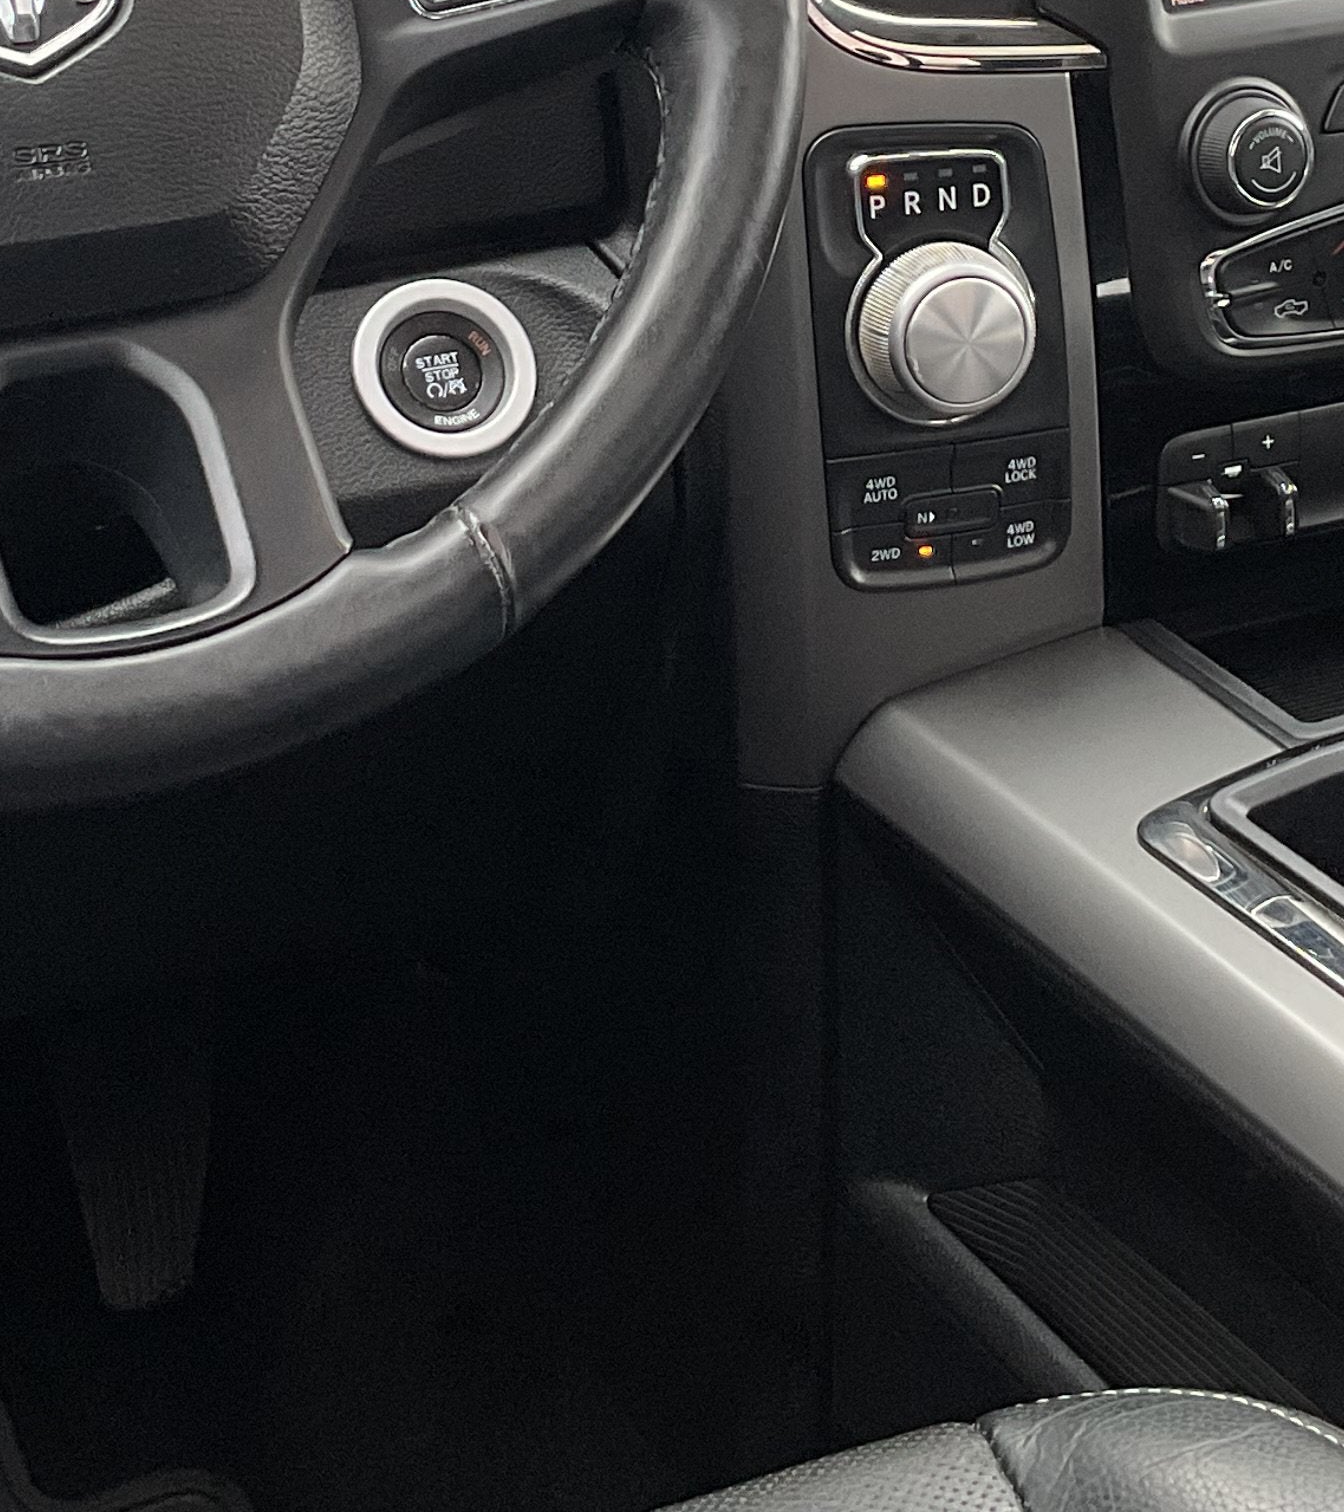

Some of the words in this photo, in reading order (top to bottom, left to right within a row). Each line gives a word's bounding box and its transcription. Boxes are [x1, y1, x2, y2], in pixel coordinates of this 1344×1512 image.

[1253, 127, 1287, 144] VOLUME
[869, 195, 886, 219] P
[904, 191, 922, 215] R
[938, 186, 957, 211] N
[972, 183, 991, 207] D
[1269, 259, 1293, 273] A/C
[468, 331, 492, 357] RUN
[415, 351, 458, 370] START
[424, 368, 459, 384] STOP
[434, 409, 480, 427] ENGINE
[1008, 456, 1037, 470] 4WD
[866, 476, 896, 490] 4WD
[1005, 469, 1037, 484] LOCK
[863, 488, 898, 504] AUTO
[917, 512, 928, 524] N
[1007, 521, 1035, 536] 4WD
[1007, 533, 1035, 548] LOW
[871, 547, 901, 562] 2WD
